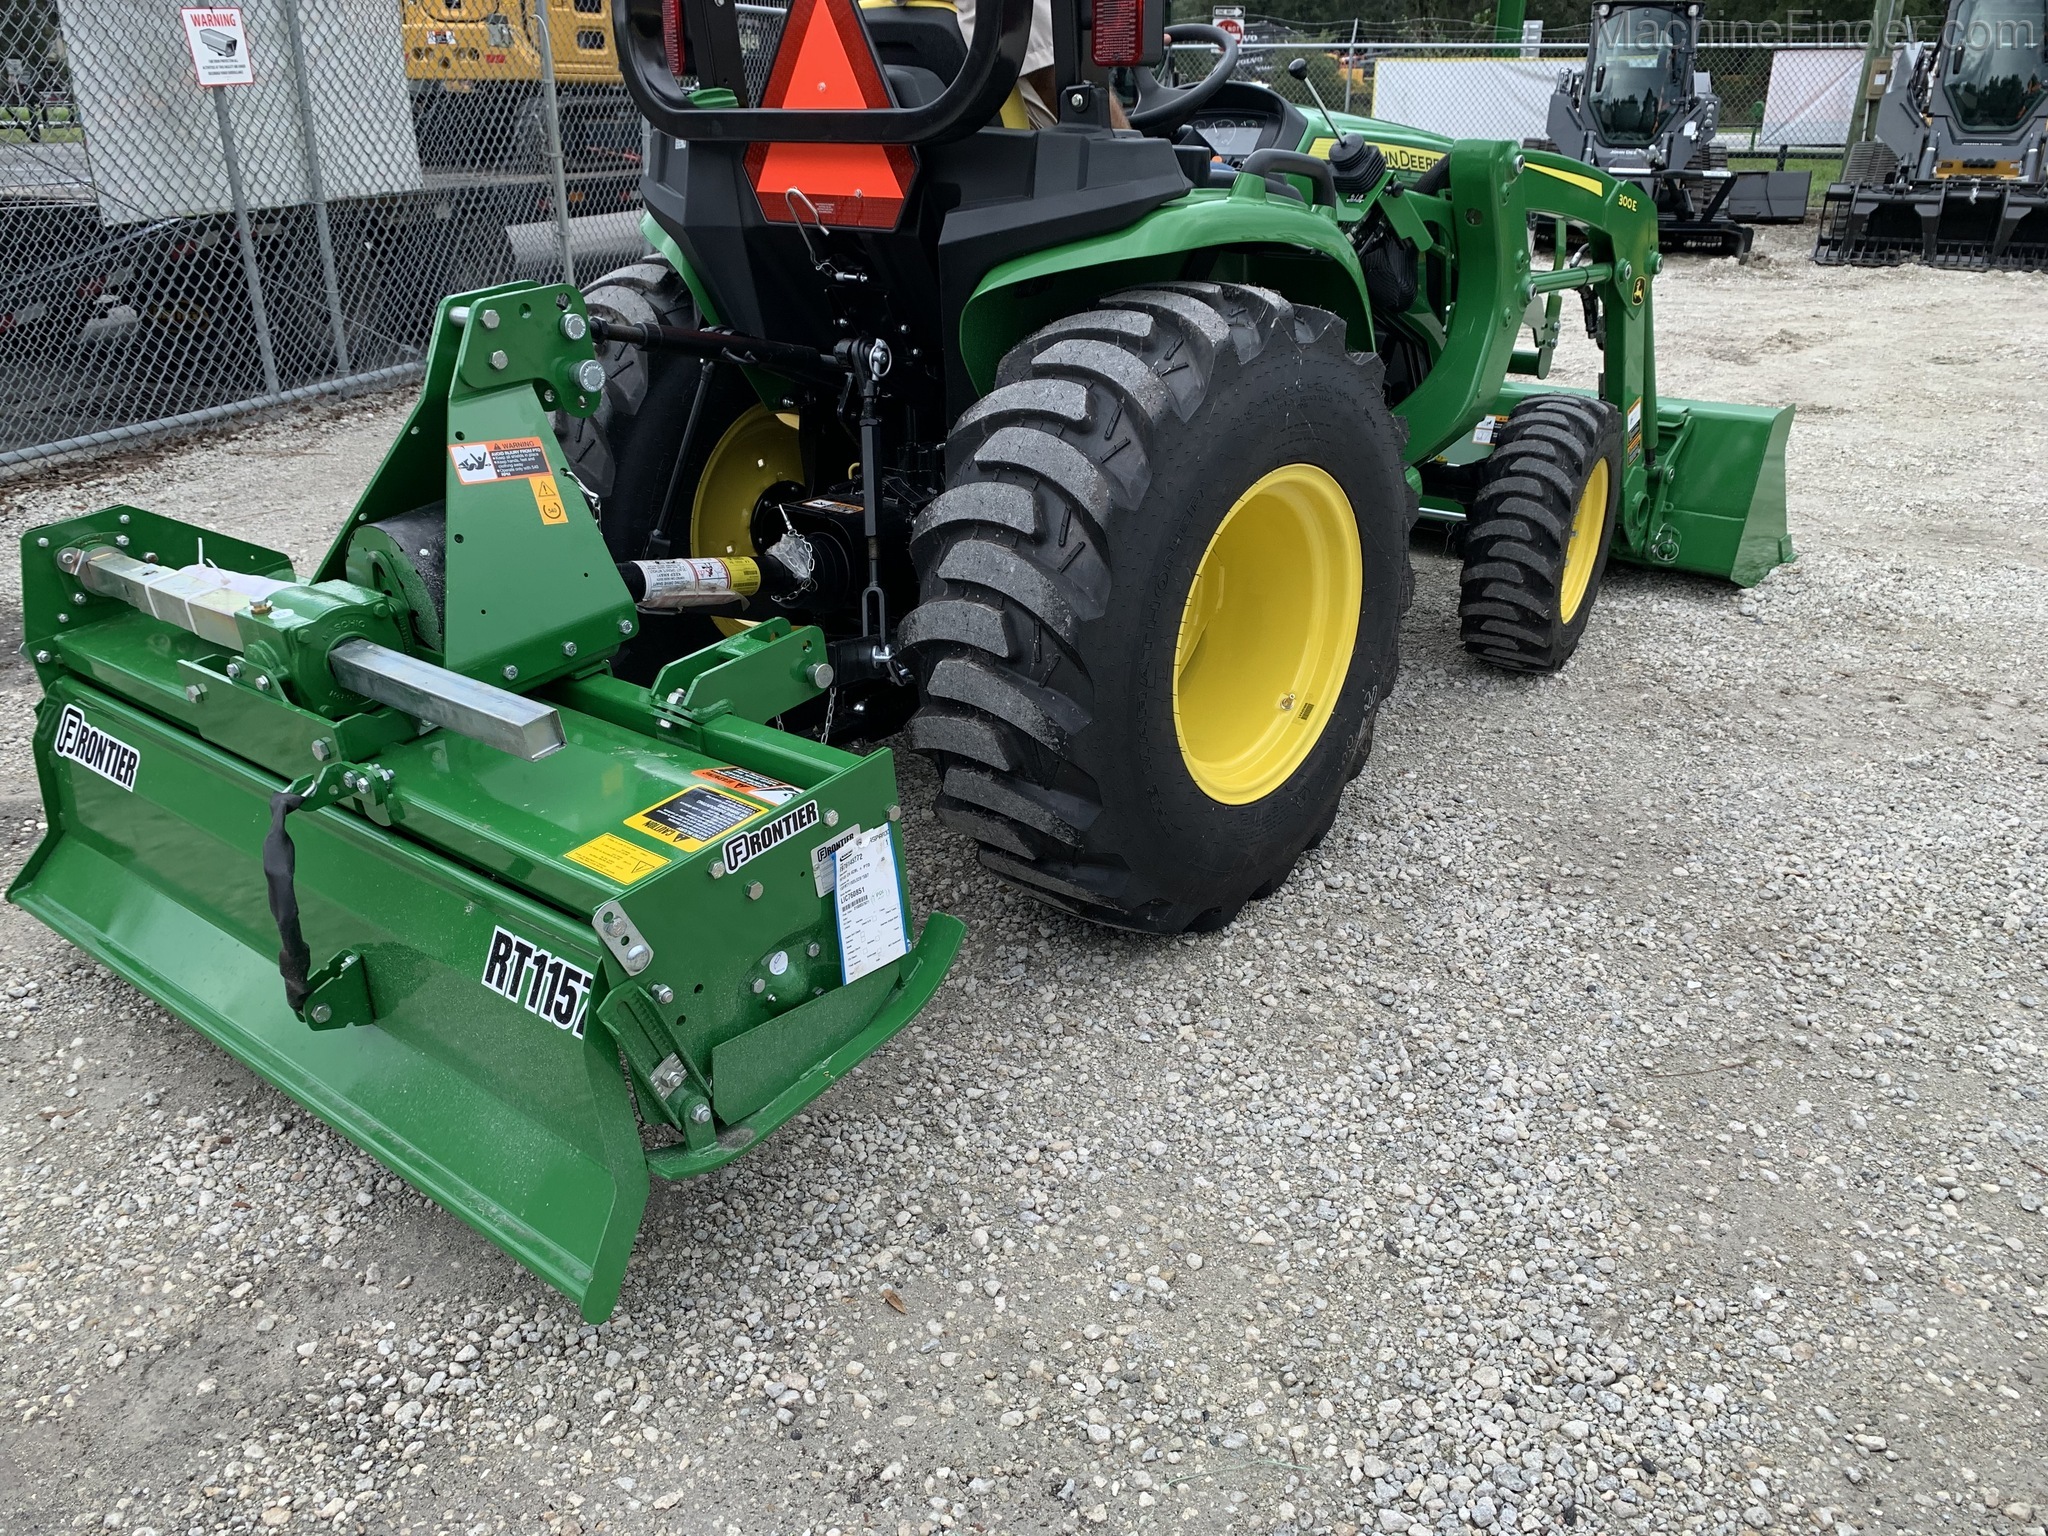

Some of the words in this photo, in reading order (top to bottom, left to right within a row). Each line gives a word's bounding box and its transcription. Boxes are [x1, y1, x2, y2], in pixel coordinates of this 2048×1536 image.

[190, 13, 236, 27] WARNING
[1618, 193, 1638, 212] 300E
[502, 441, 534, 450] WARNING
[57, 708, 138, 787] FRONTIER
[725, 802, 818, 871] FRONTIER
[817, 833, 854, 862] FRONTIER
